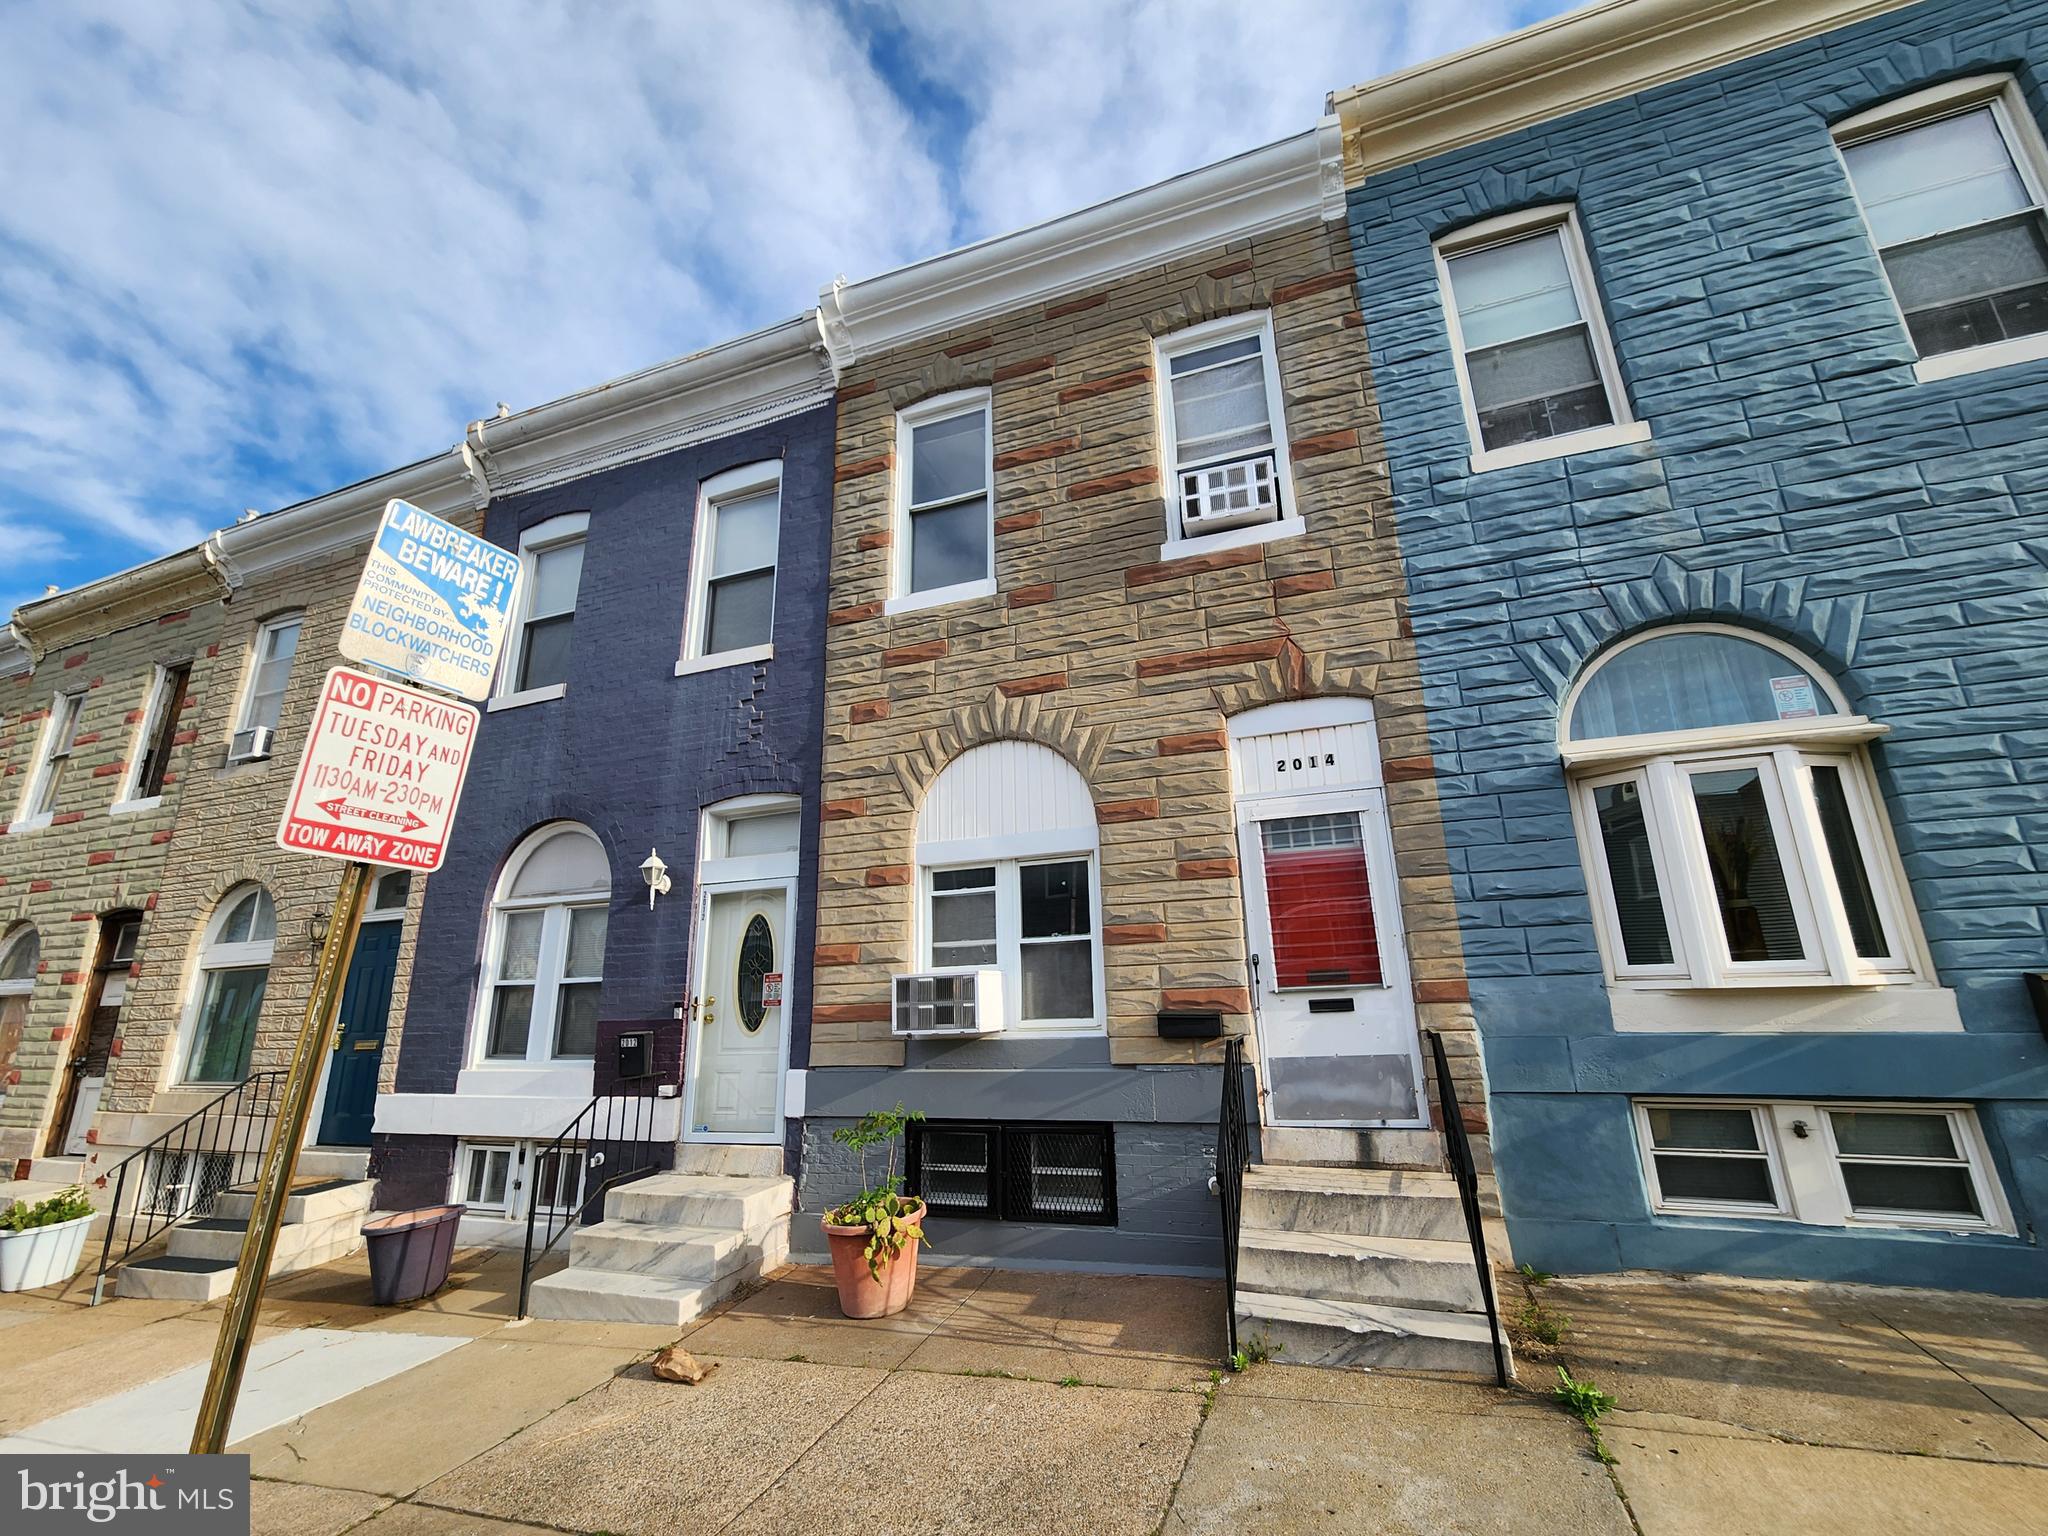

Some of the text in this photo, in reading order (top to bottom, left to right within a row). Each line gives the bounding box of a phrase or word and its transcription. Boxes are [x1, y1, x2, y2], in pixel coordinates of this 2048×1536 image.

[388, 503, 517, 583] LAWBREAKER
[371, 559, 397, 575] THIS
[363, 580, 431, 611] PROTECTED
[367, 570, 437, 603] COMMUNITY
[363, 595, 493, 657] NEIGHBORHOOD
[330, 675, 469, 735] NO PARKING
[330, 711, 460, 765] TUESDAY AND
[349, 746, 430, 783] FRIDAY
[1277, 754, 1335, 772] 2014
[326, 803, 419, 828] STREET CLEANING
[289, 823, 436, 865] TOW AWAY ZONE
